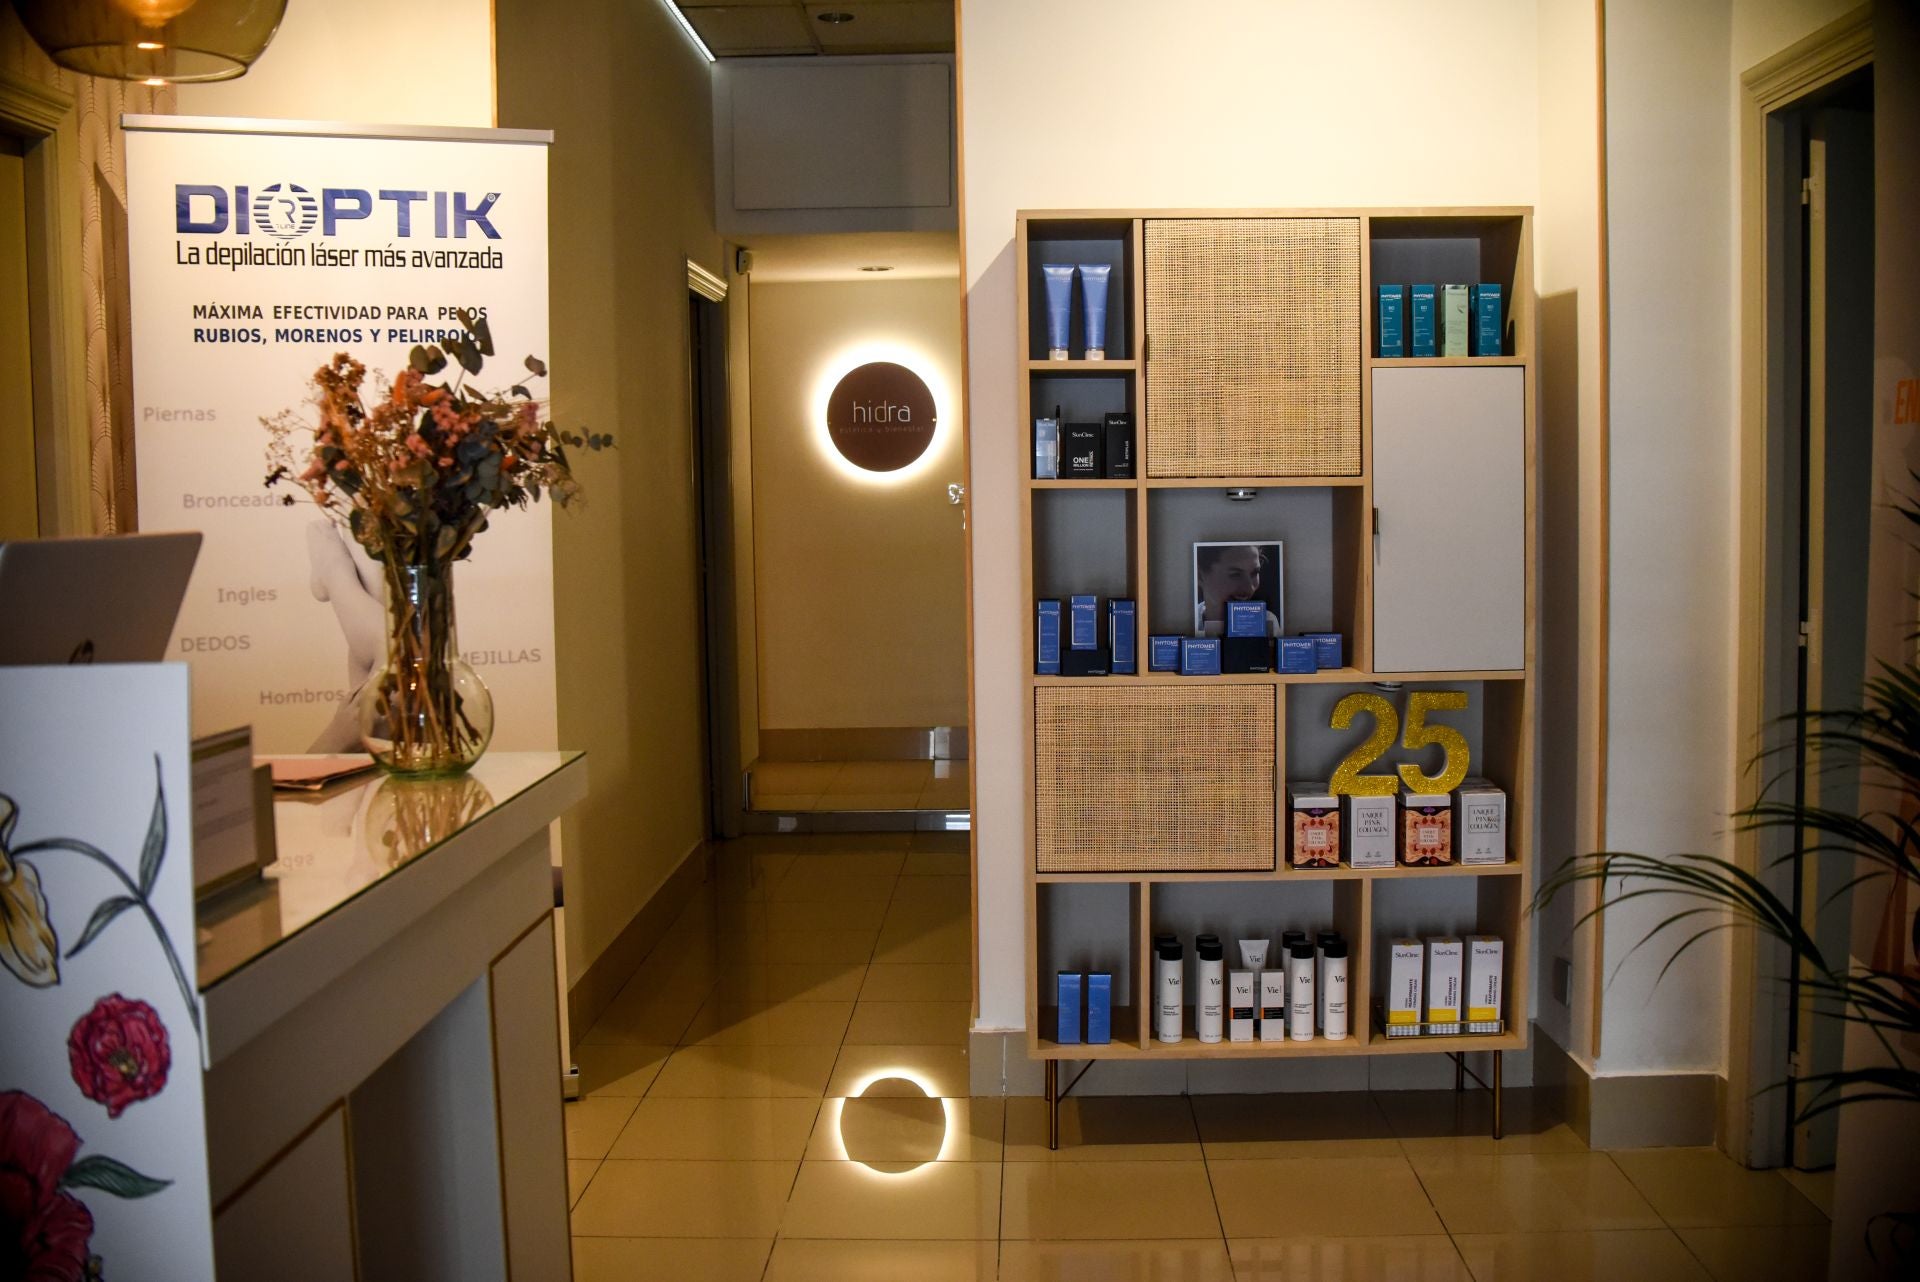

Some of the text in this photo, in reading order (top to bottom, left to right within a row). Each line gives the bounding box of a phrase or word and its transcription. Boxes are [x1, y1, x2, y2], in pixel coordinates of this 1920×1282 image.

[175, 182, 503, 240] DIOPTIK
[176, 241, 503, 272] La depilación láser más avanzada
[193, 301, 488, 321] MÁXIMA EFECTIVIDAD PARA PEOS
[194, 328, 267, 346] RUBIOS,
[275, 329, 363, 344] MORENOS
[370, 330, 381, 343] Y
[143, 407, 217, 423] Piernas
[853, 400, 911, 423] hidra
[217, 586, 278, 606] Ingles
[180, 635, 251, 653] DEDOS
[259, 688, 347, 705] Hombros
[1328, 691, 1471, 796] 25
[1299, 976, 1311, 984] Vie
